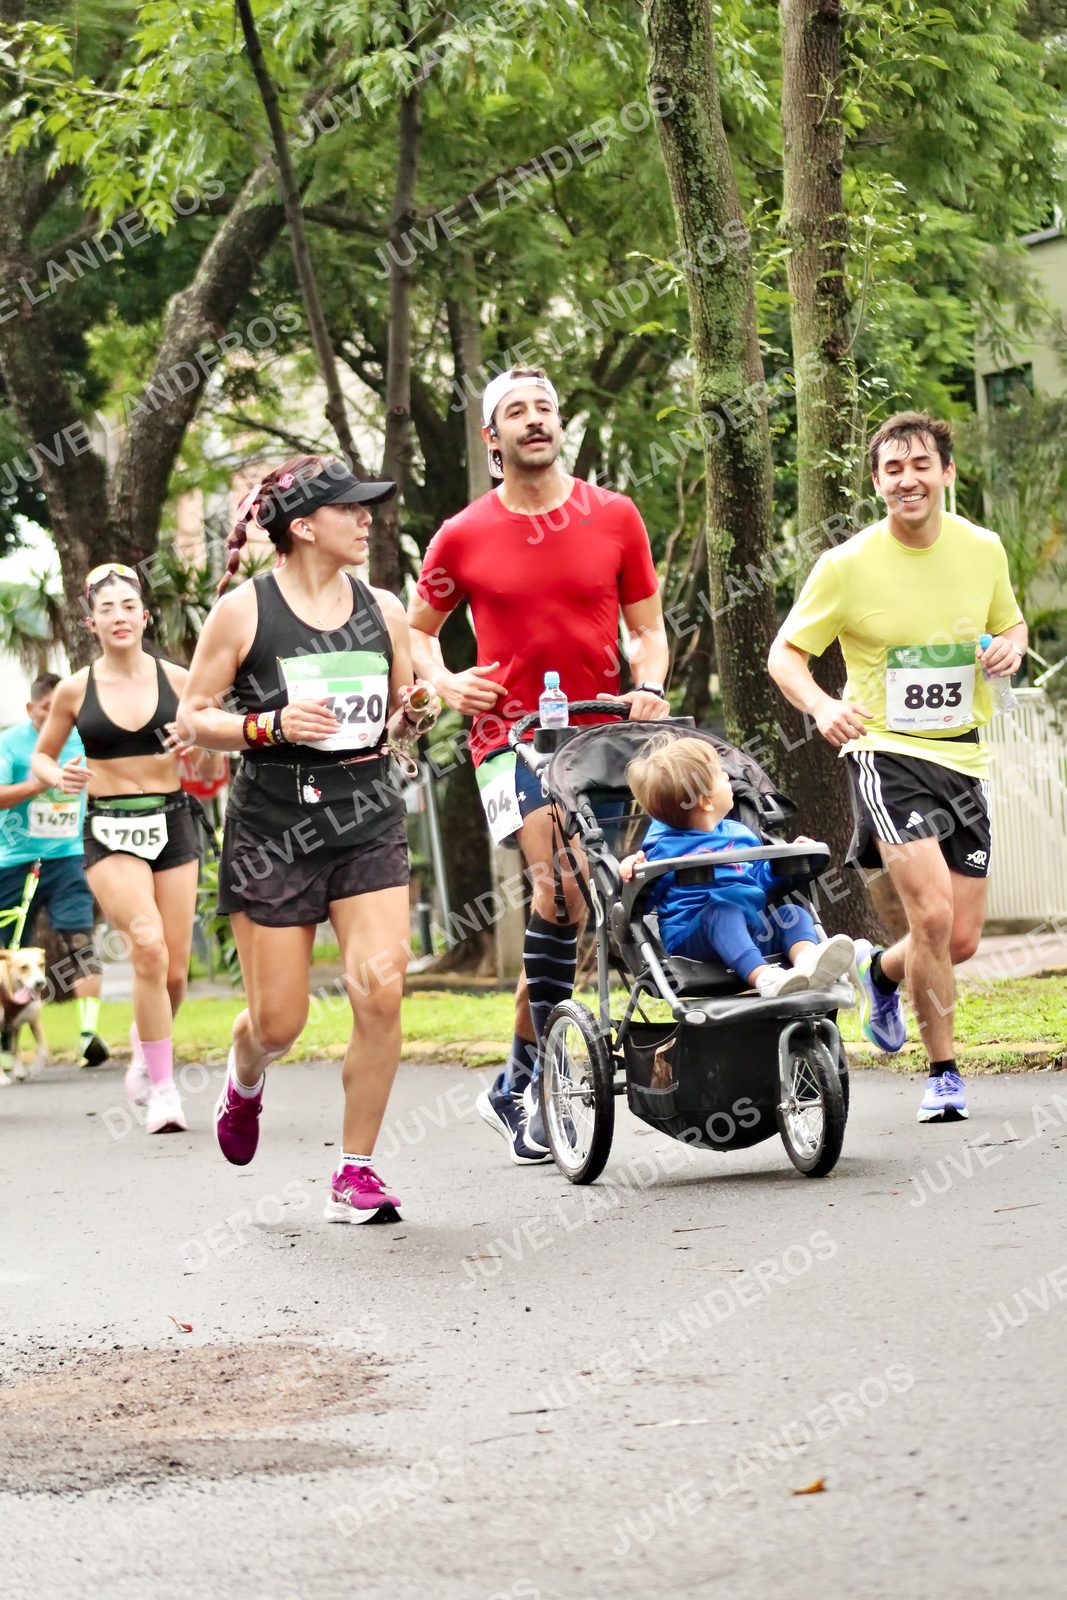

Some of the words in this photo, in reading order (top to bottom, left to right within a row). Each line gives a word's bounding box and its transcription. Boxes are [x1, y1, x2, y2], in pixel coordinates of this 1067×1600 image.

[904, 681, 962, 710] 883
[36, 812, 77, 826] 1479
[101, 827, 161, 846] 1705
